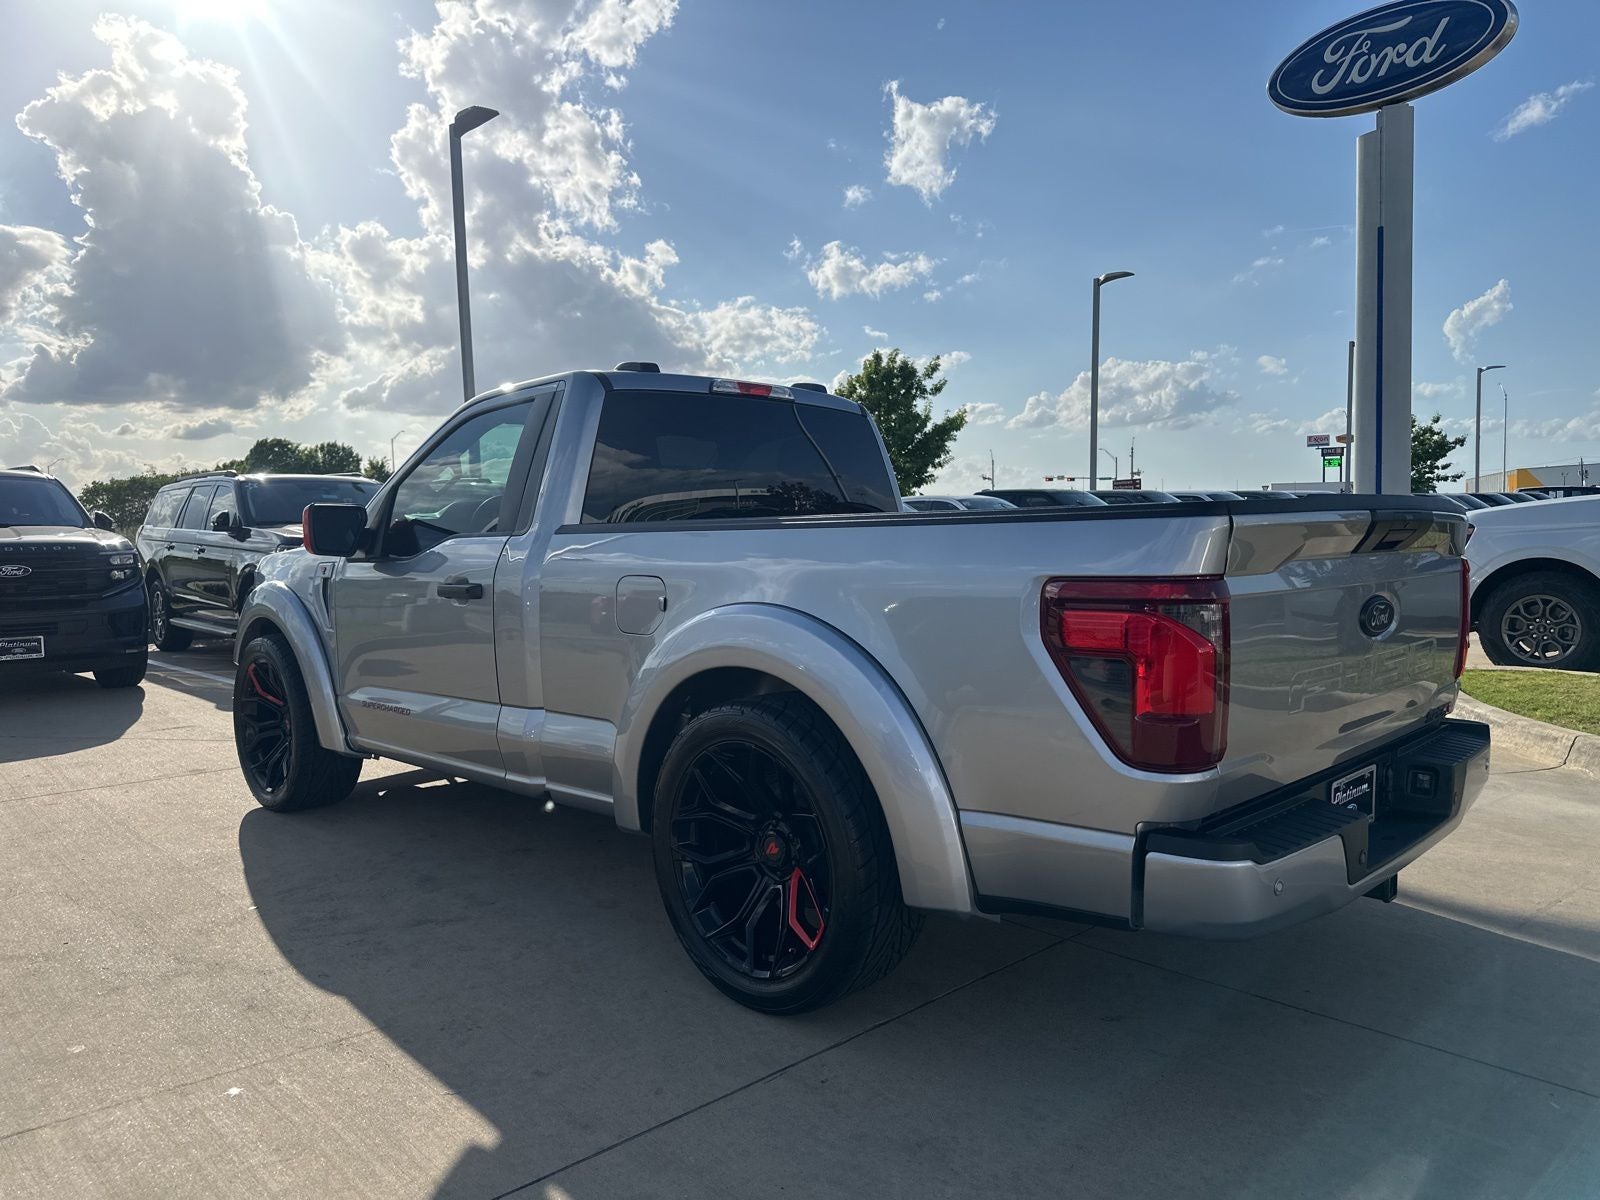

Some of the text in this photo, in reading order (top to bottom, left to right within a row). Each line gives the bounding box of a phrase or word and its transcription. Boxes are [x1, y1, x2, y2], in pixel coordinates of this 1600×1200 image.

[1311, 15, 1450, 95] Ford
[0, 566, 25, 576] Ford
[1371, 604, 1390, 627] Ford
[361, 701, 411, 716] SUPERCHARGED
[1334, 783, 1371, 805] Platinum
